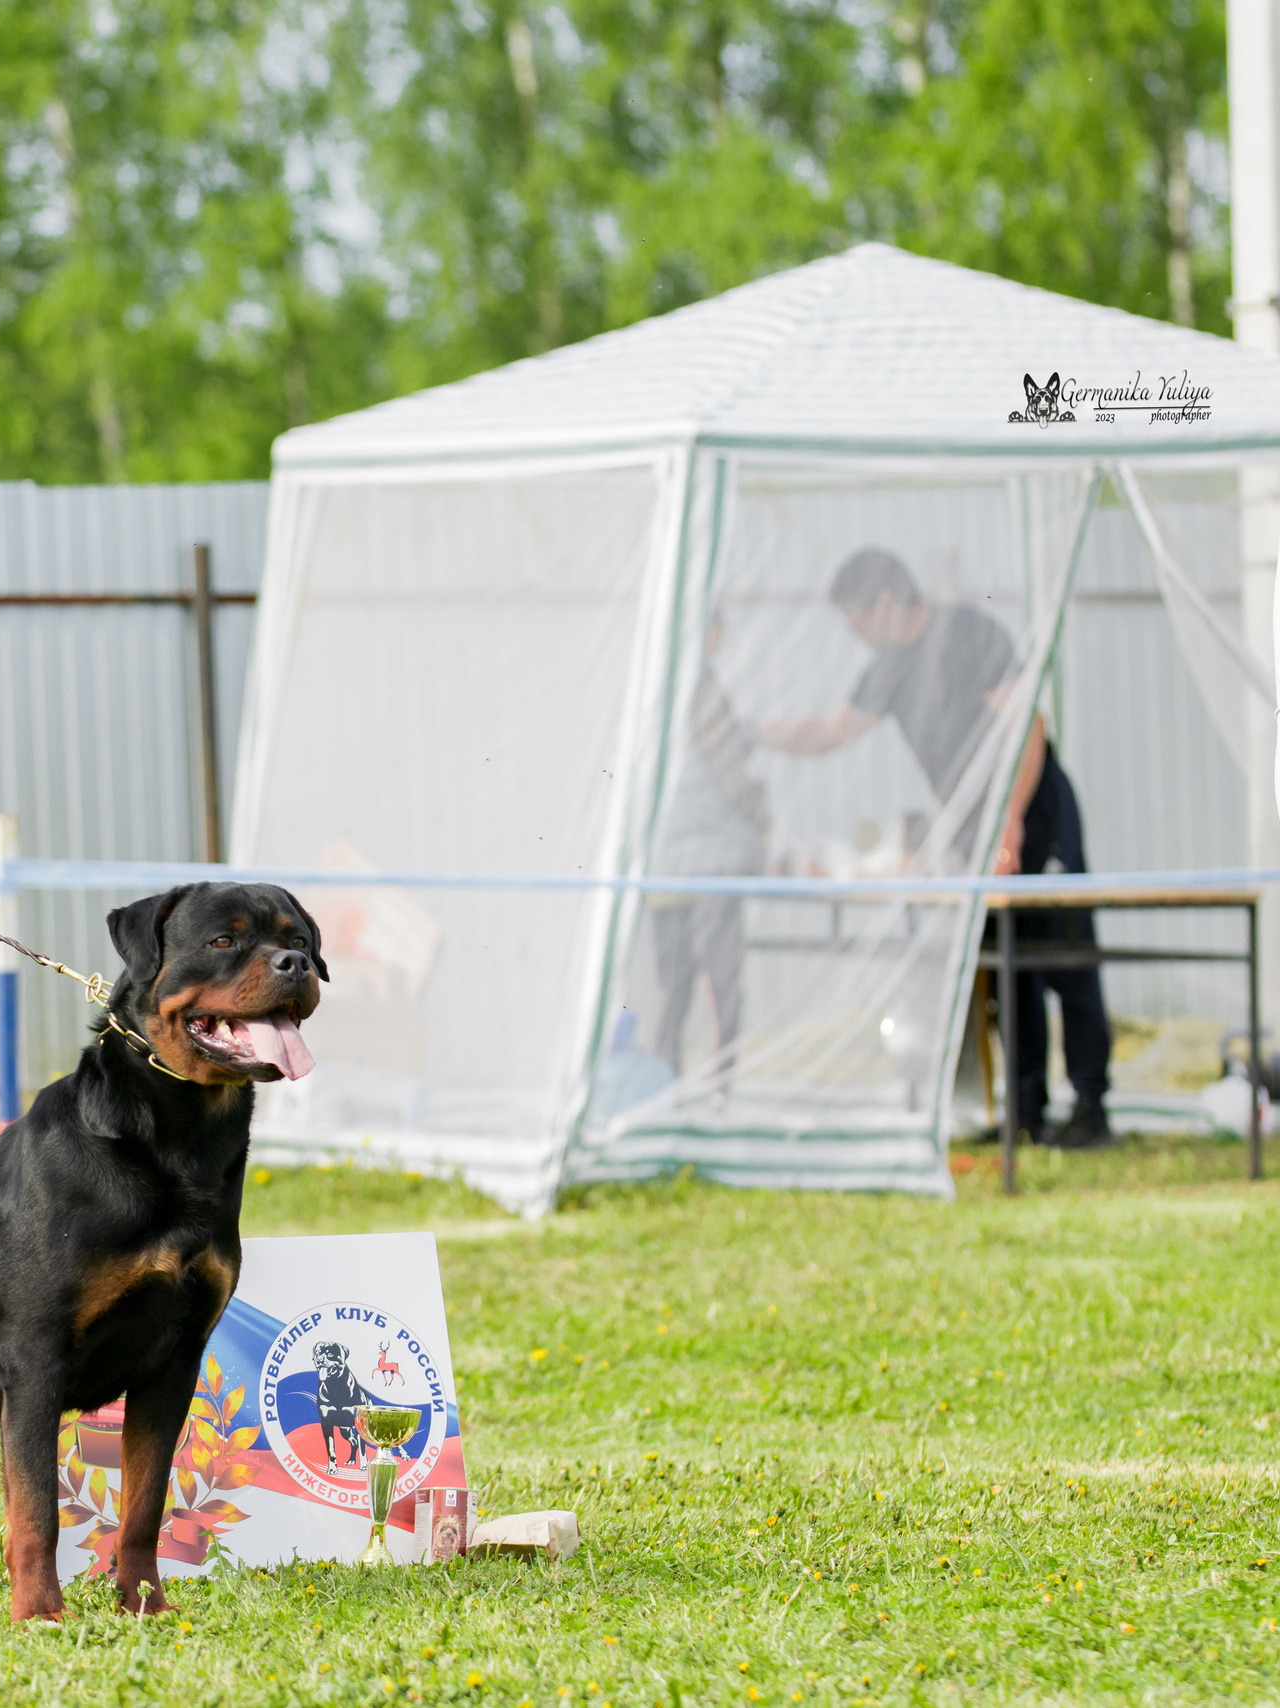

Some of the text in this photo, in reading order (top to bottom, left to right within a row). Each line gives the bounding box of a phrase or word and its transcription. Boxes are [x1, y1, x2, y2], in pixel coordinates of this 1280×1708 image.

[263, 1307, 445, 1422] РОТВЕЙЛЕР КЛУБ РОССИИ
[283, 1445, 440, 1505] НИЖЕГОРОКОЕ РО
